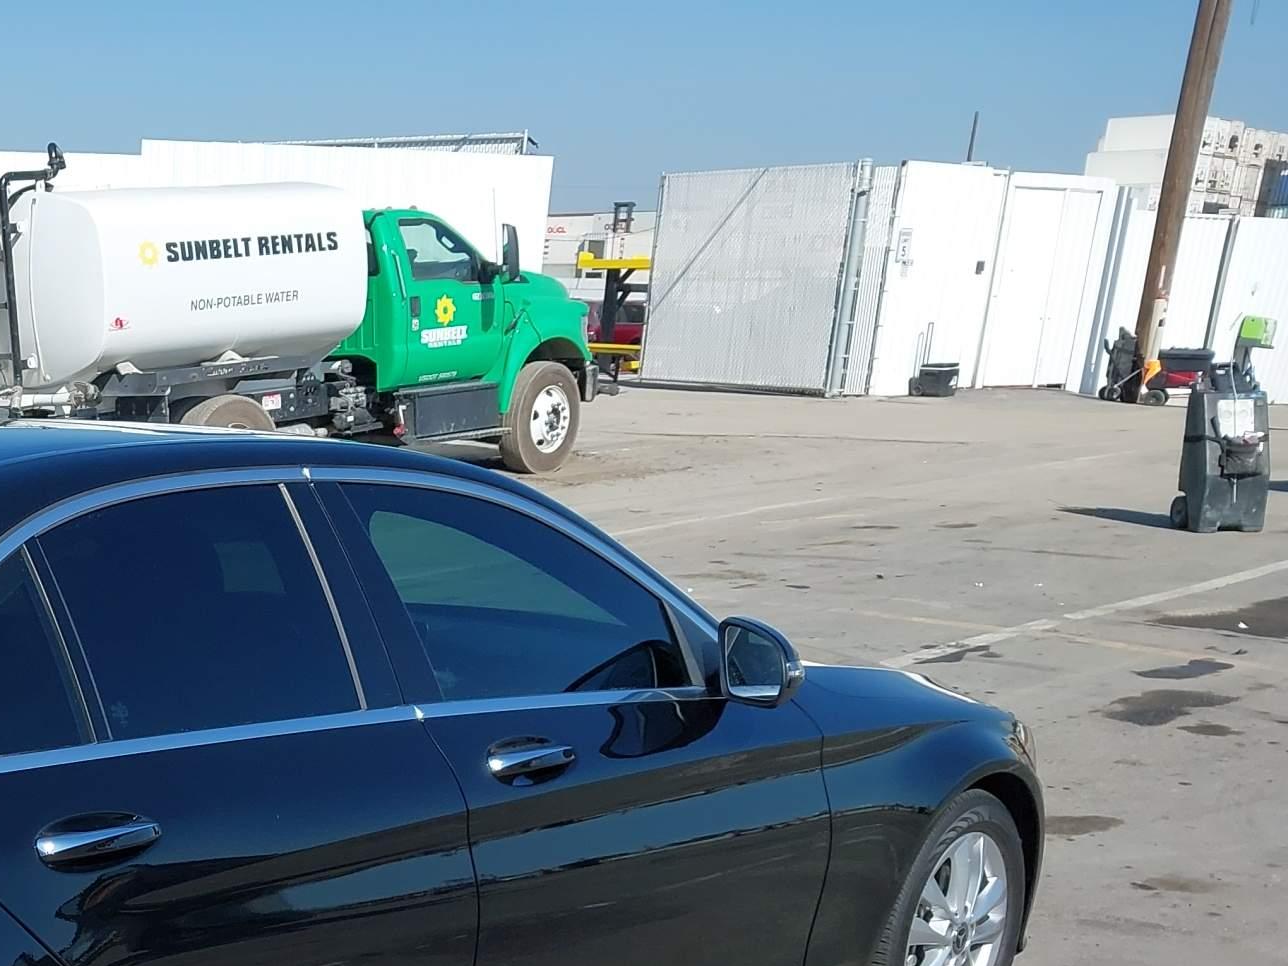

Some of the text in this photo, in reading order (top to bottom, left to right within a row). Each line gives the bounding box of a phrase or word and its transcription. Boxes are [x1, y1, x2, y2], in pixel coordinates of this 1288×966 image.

[165, 231, 339, 263] SUNBELT RENTALS
[190, 289, 299, 312] NON-POTABLE WATER
